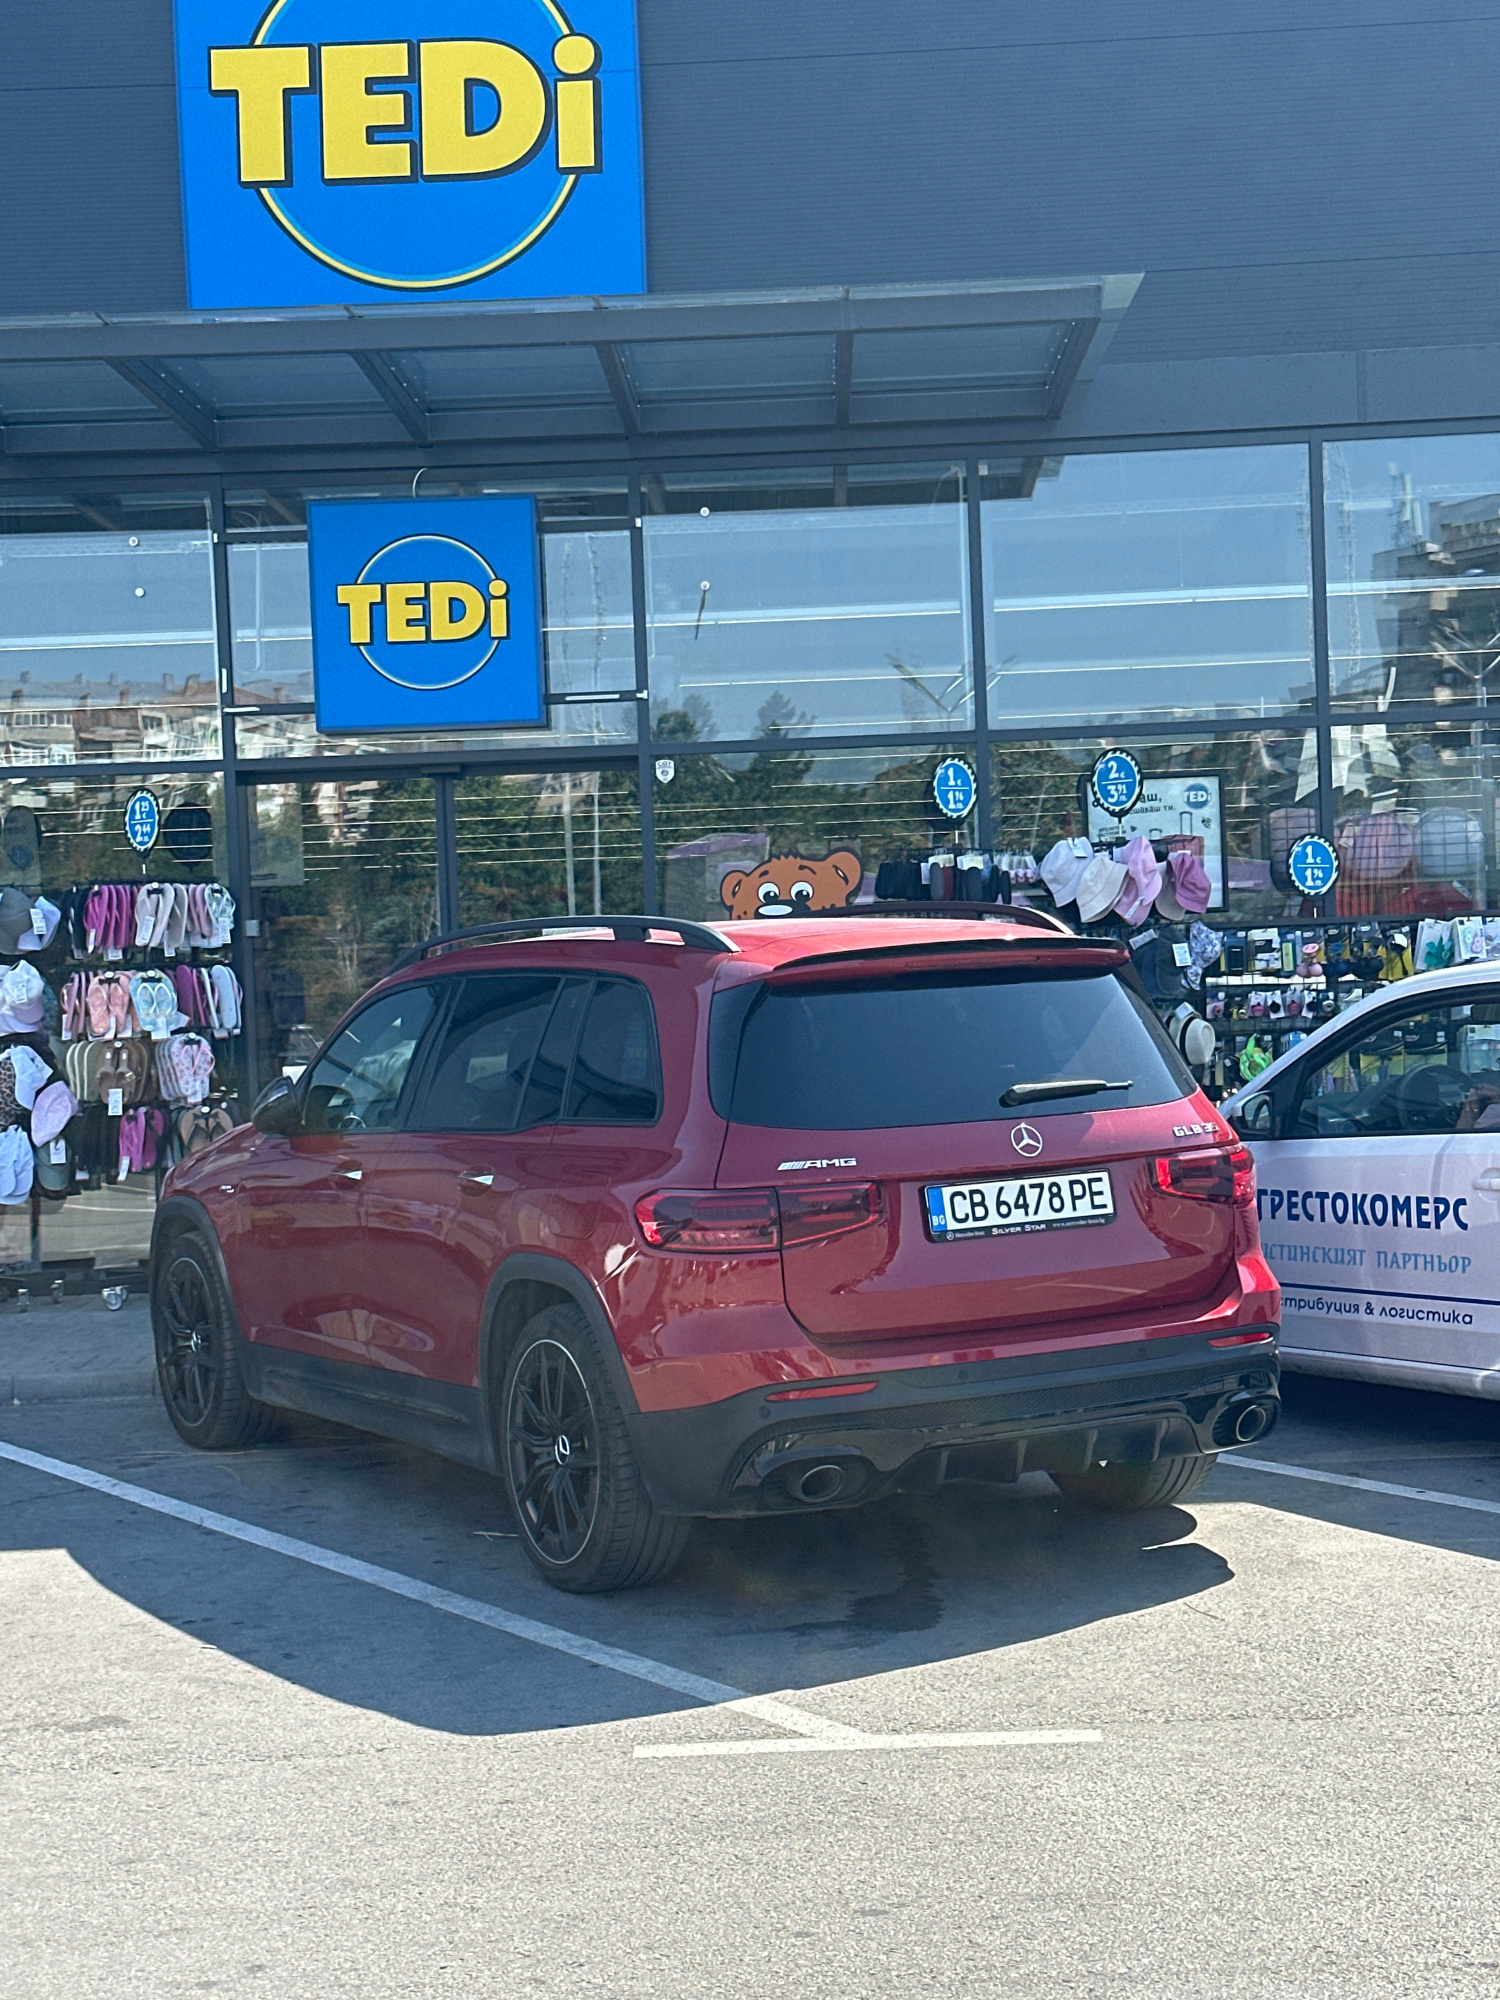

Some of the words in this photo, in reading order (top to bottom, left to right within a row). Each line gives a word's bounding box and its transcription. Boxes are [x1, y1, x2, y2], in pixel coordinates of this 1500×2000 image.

[208, 33, 602, 188] TEDi
[336, 578, 510, 645] TEDi
[1140, 793, 1162, 803] аш,
[1130, 805, 1161, 814] шаваш
[1173, 1124, 1202, 1137] GLB
[804, 1158, 857, 1169] AMG
[950, 1189, 989, 1224] CB
[996, 1182, 1065, 1219] 6478
[1068, 1177, 1107, 1211] PE
[932, 1215, 946, 1226] BG
[1376, 1251, 1471, 1274] ПАРТНЬОР
[1281, 1297, 1359, 1314] трибуция
[1365, 1302, 1374, 1315] &
[1379, 1306, 1473, 1325] логистика
